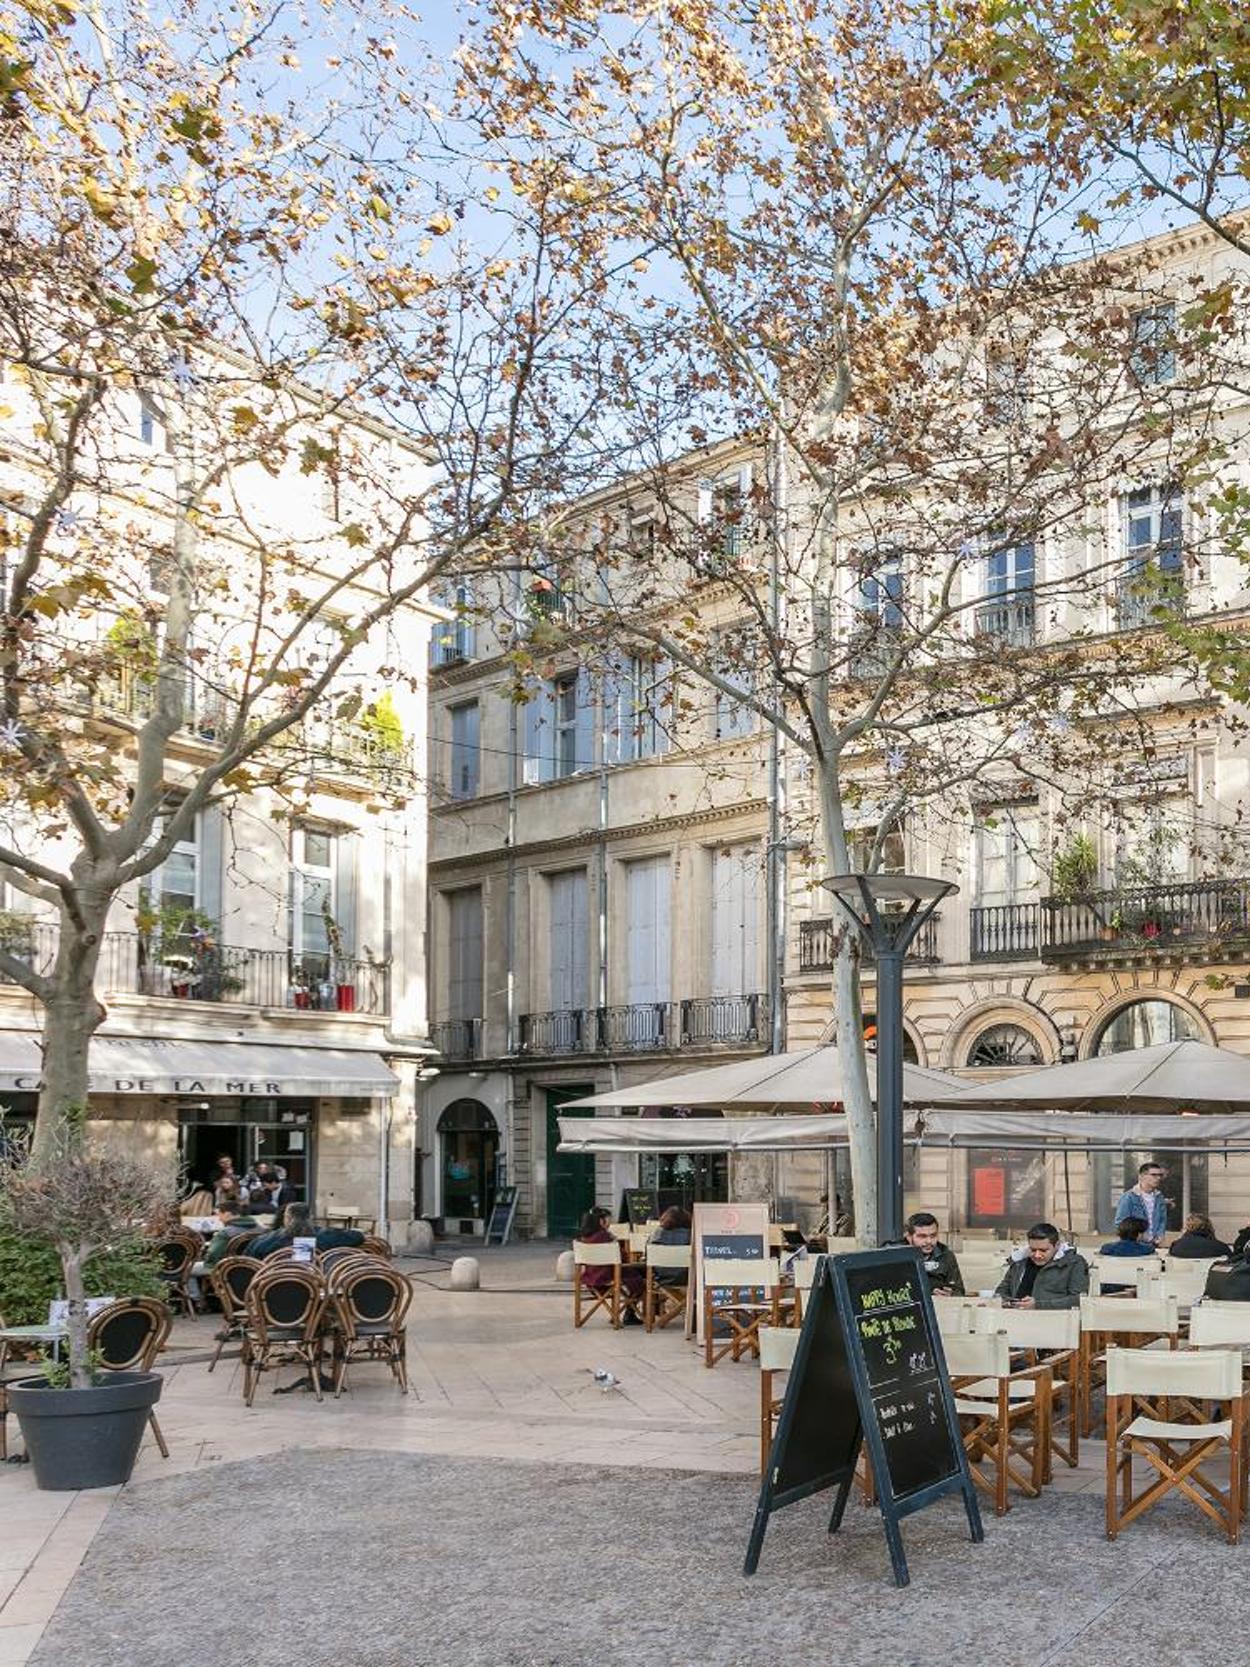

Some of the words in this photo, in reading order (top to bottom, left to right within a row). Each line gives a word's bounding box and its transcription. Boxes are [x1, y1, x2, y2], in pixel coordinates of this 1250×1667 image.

[115, 1079, 154, 1091] DE
[174, 1081, 206, 1092] LA
[226, 1083, 281, 1094] MER
